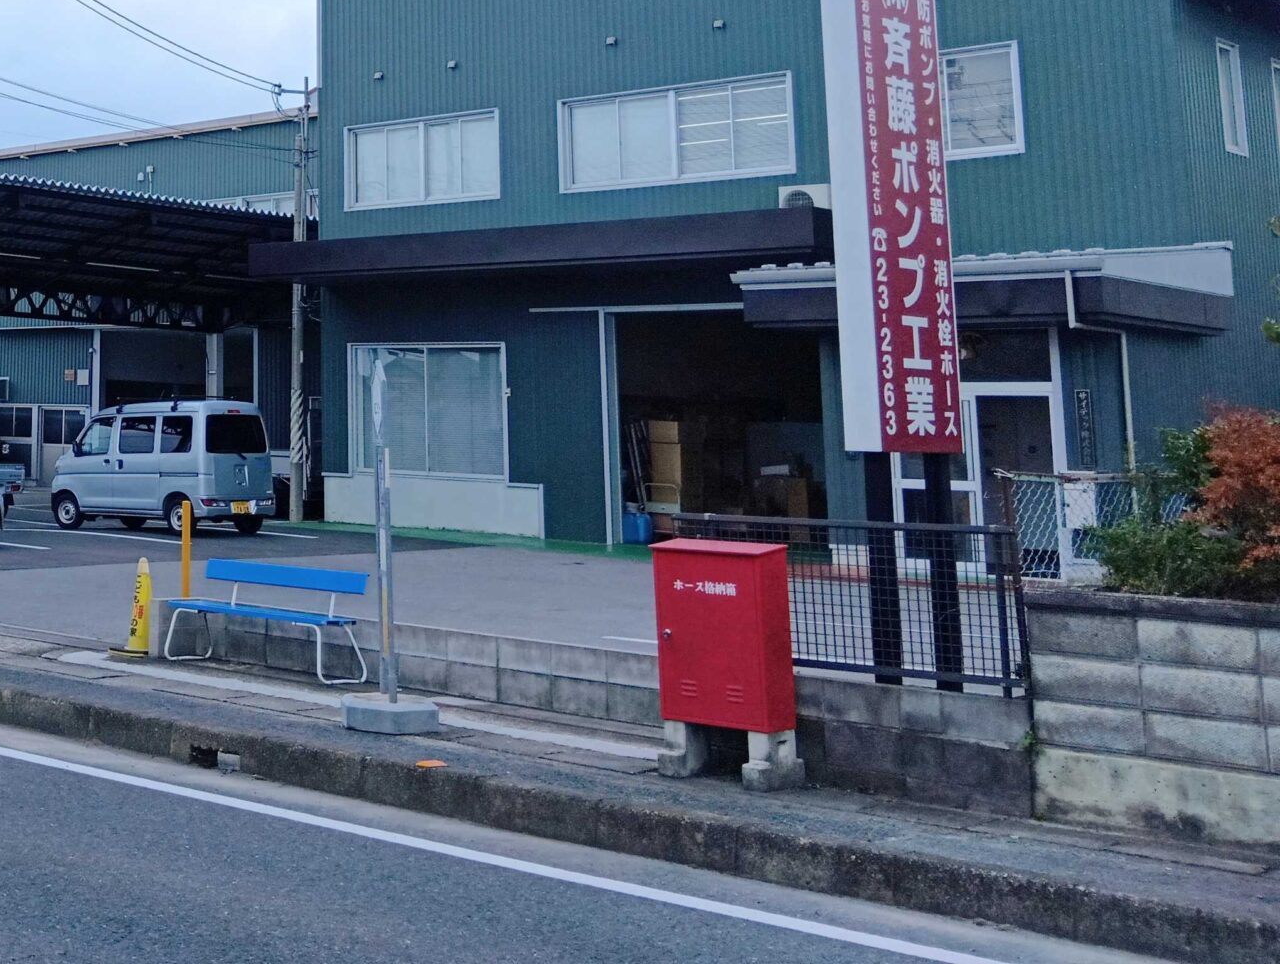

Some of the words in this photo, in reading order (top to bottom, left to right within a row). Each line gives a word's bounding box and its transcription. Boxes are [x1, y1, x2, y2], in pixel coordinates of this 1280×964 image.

[673, 579, 736, 596] ホース格納箱
